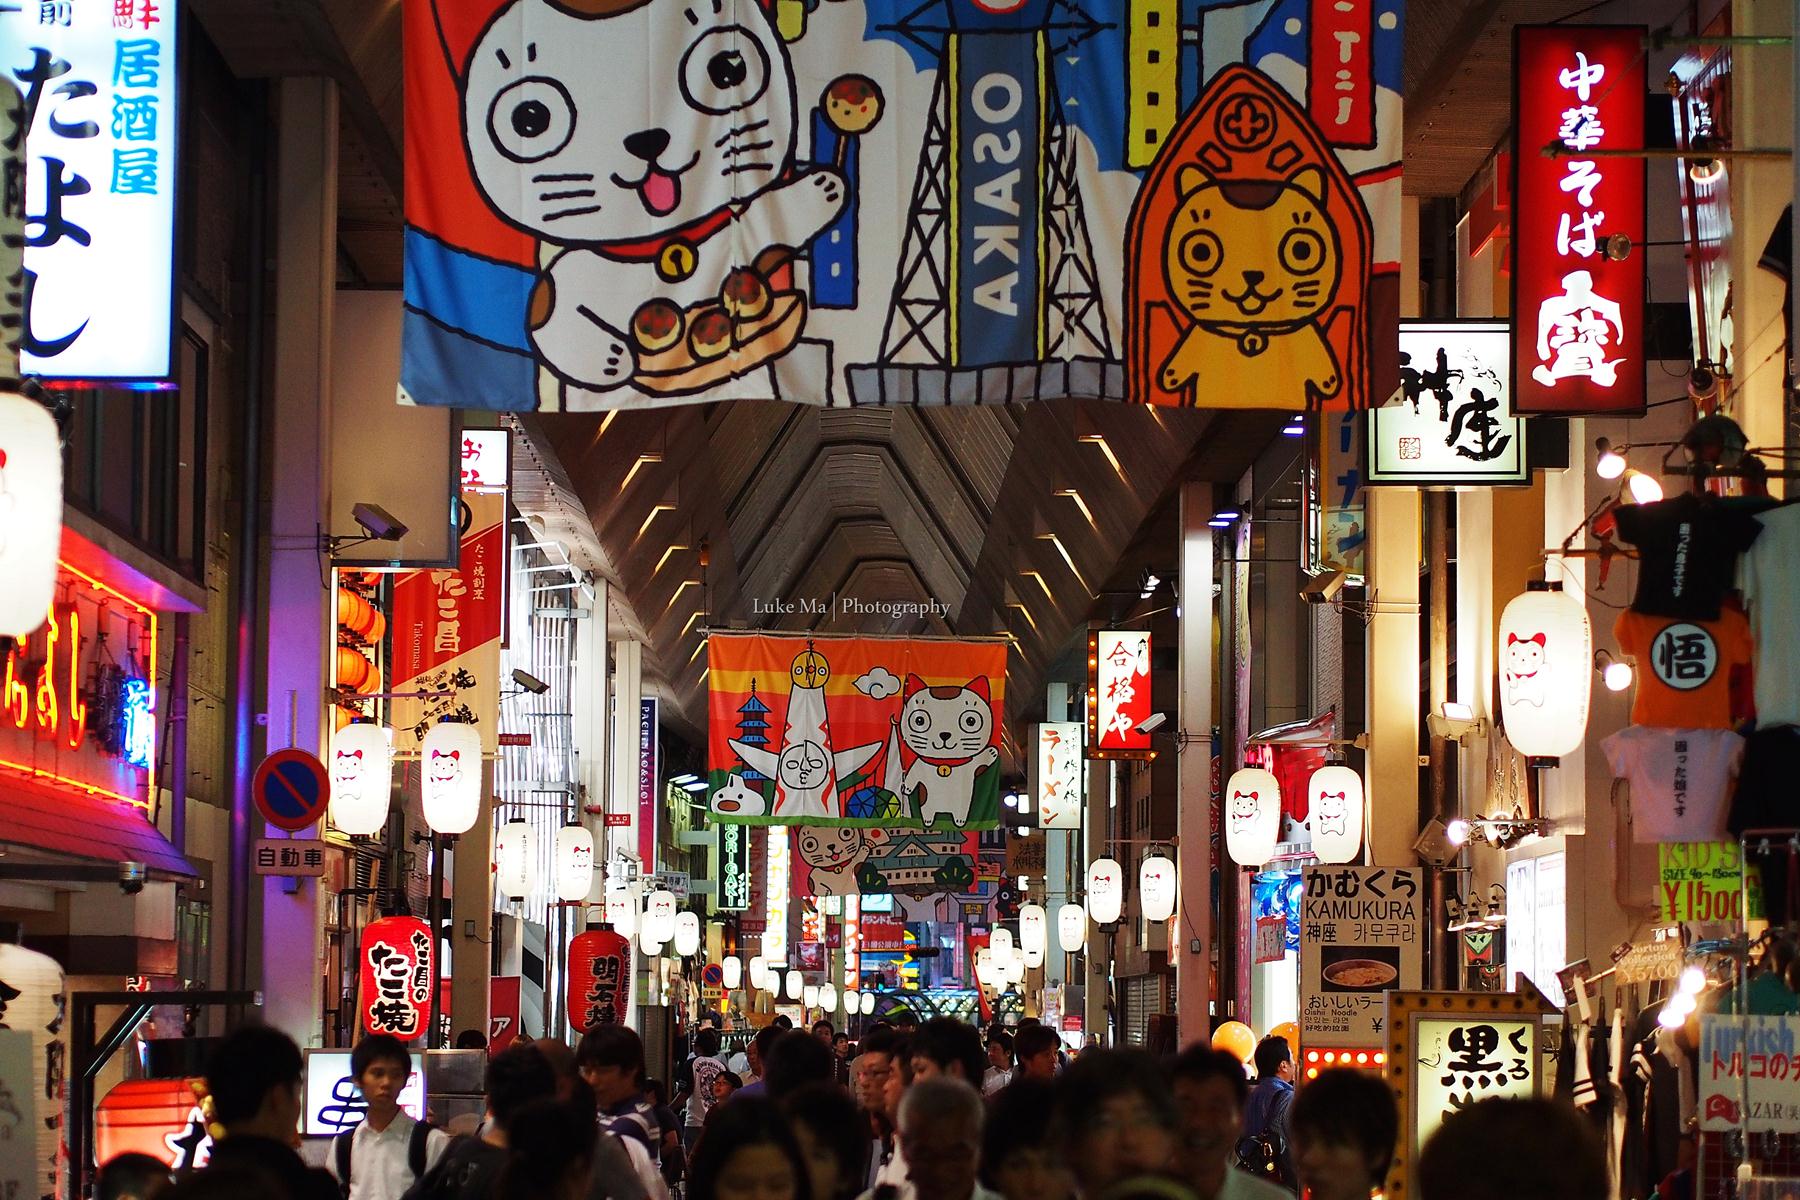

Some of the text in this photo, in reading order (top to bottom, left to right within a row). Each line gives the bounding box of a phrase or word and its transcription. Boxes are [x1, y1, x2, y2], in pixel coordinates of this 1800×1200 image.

[1558, 51, 1605, 258] 中華そば
[12, 47, 99, 358] たよし
[414, 622, 423, 669] Takomasa
[1659, 631, 1706, 680] 悟
[1107, 641, 1135, 742] 合格や
[1042, 729, 1061, 825] ラーメン
[257, 845, 323, 869] 自動車
[1306, 869, 1417, 898] かむくら
[1305, 900, 1416, 920] KAMUKURA
[1306, 921, 1337, 943] 神座
[1354, 923, 1416, 943] 카무쿠라
[369, 941, 419, 1034] たこ焼
[410, 929, 430, 1003] たこ昌の
[1304, 1009, 1357, 1017] Oishii Noodle
